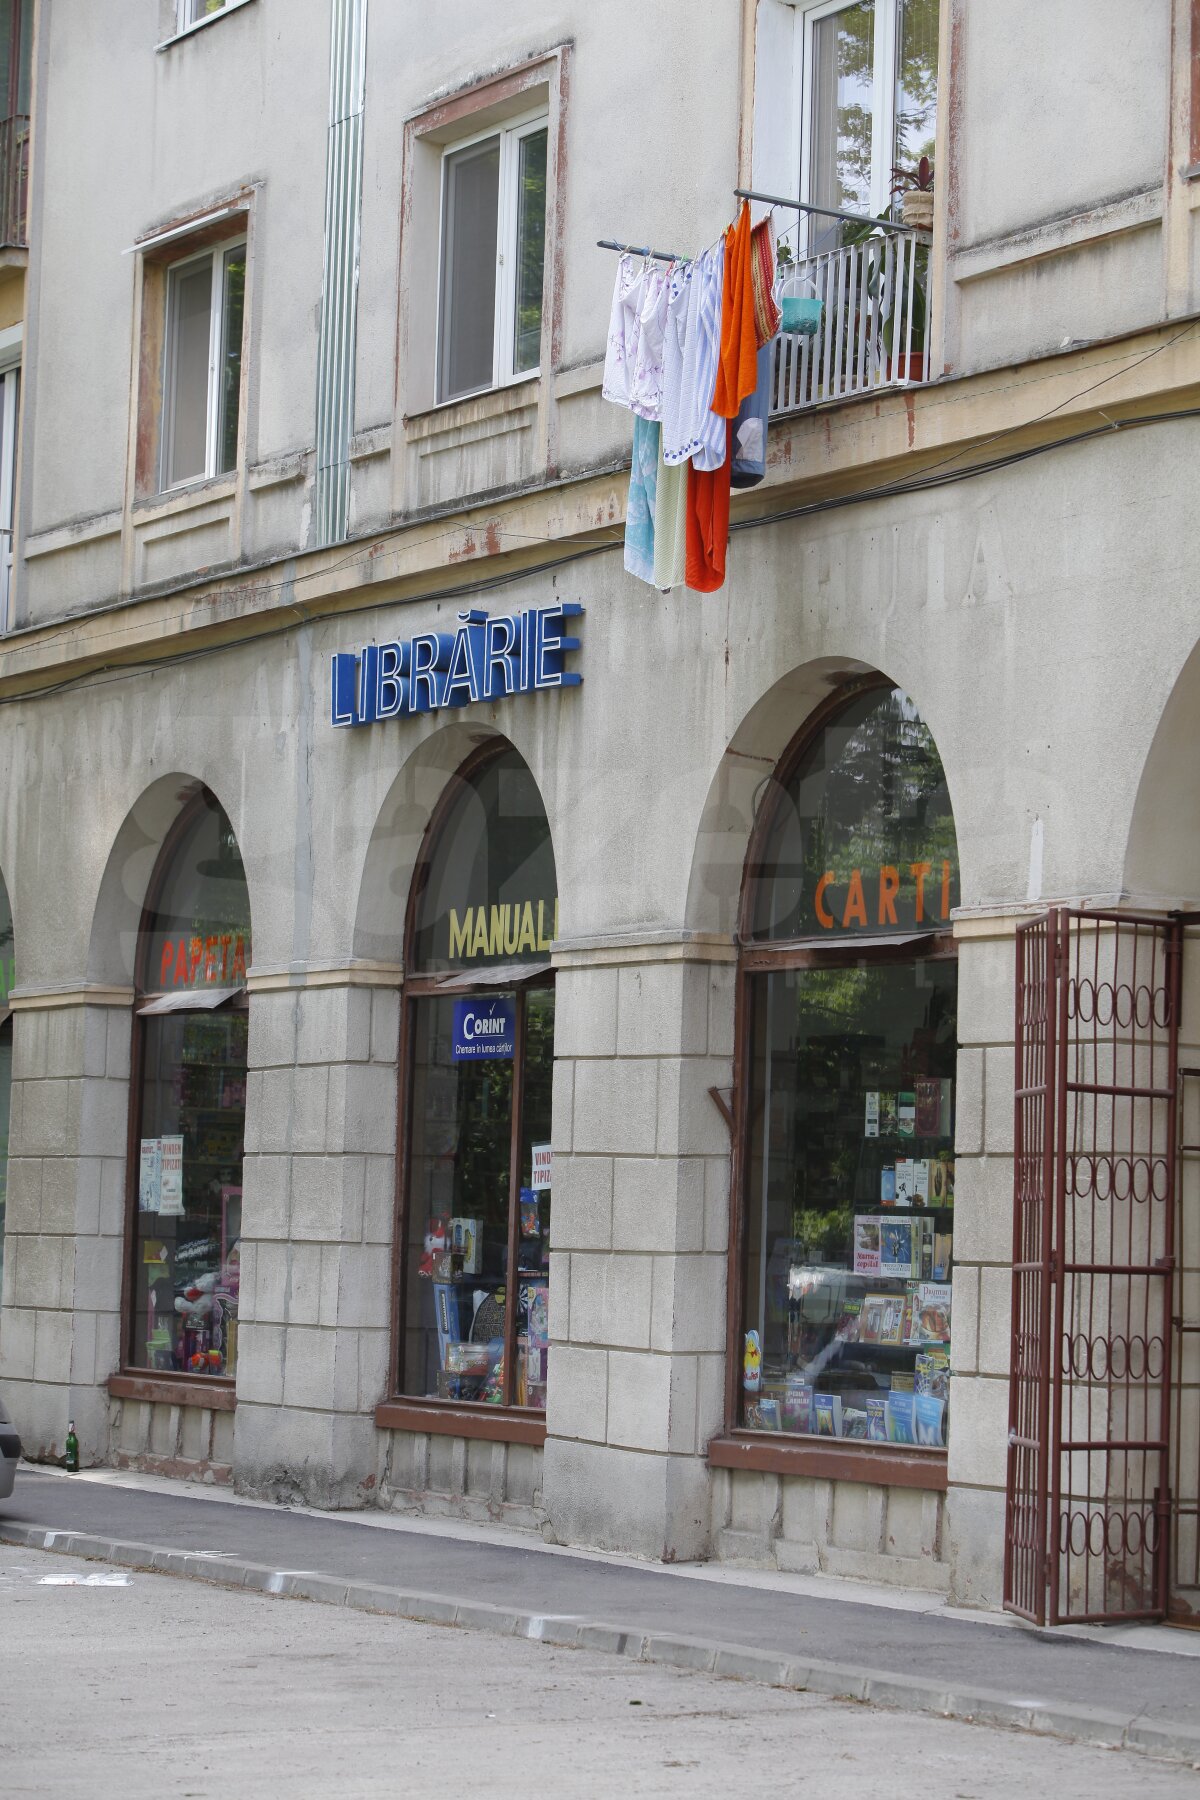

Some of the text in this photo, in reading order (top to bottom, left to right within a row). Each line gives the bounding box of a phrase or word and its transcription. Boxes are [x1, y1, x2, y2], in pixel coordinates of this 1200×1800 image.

[331, 604, 584, 729] LIBRĂRIE
[814, 859, 950, 929] CARTI
[160, 933, 252, 986] PAPETA
[455, 1044, 476, 1054] Chemare
[482, 1043, 496, 1053] lumea
